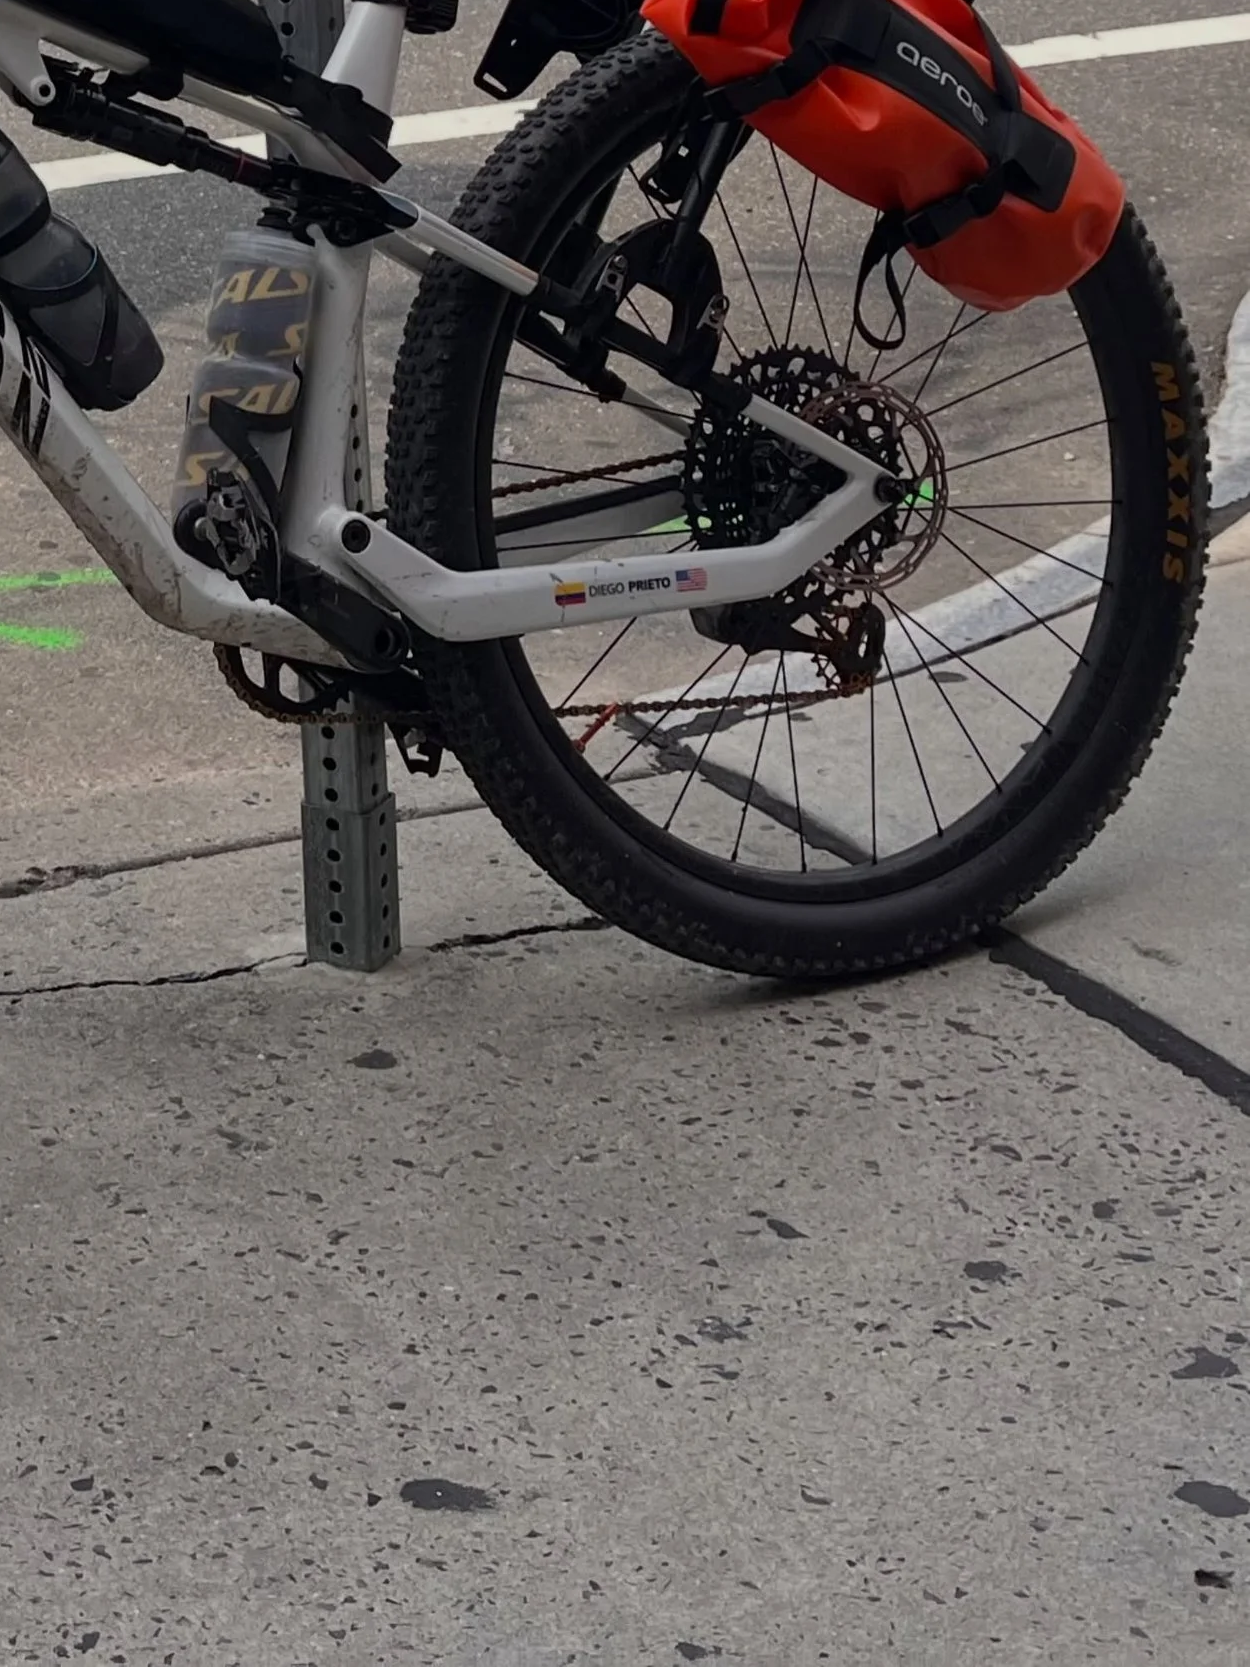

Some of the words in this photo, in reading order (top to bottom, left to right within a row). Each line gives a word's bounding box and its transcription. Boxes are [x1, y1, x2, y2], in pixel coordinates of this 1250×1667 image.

[1151, 361, 1190, 583] MAXXIS
[588, 583, 625, 598] DIEGO
[628, 577, 671, 593] PRIETO
